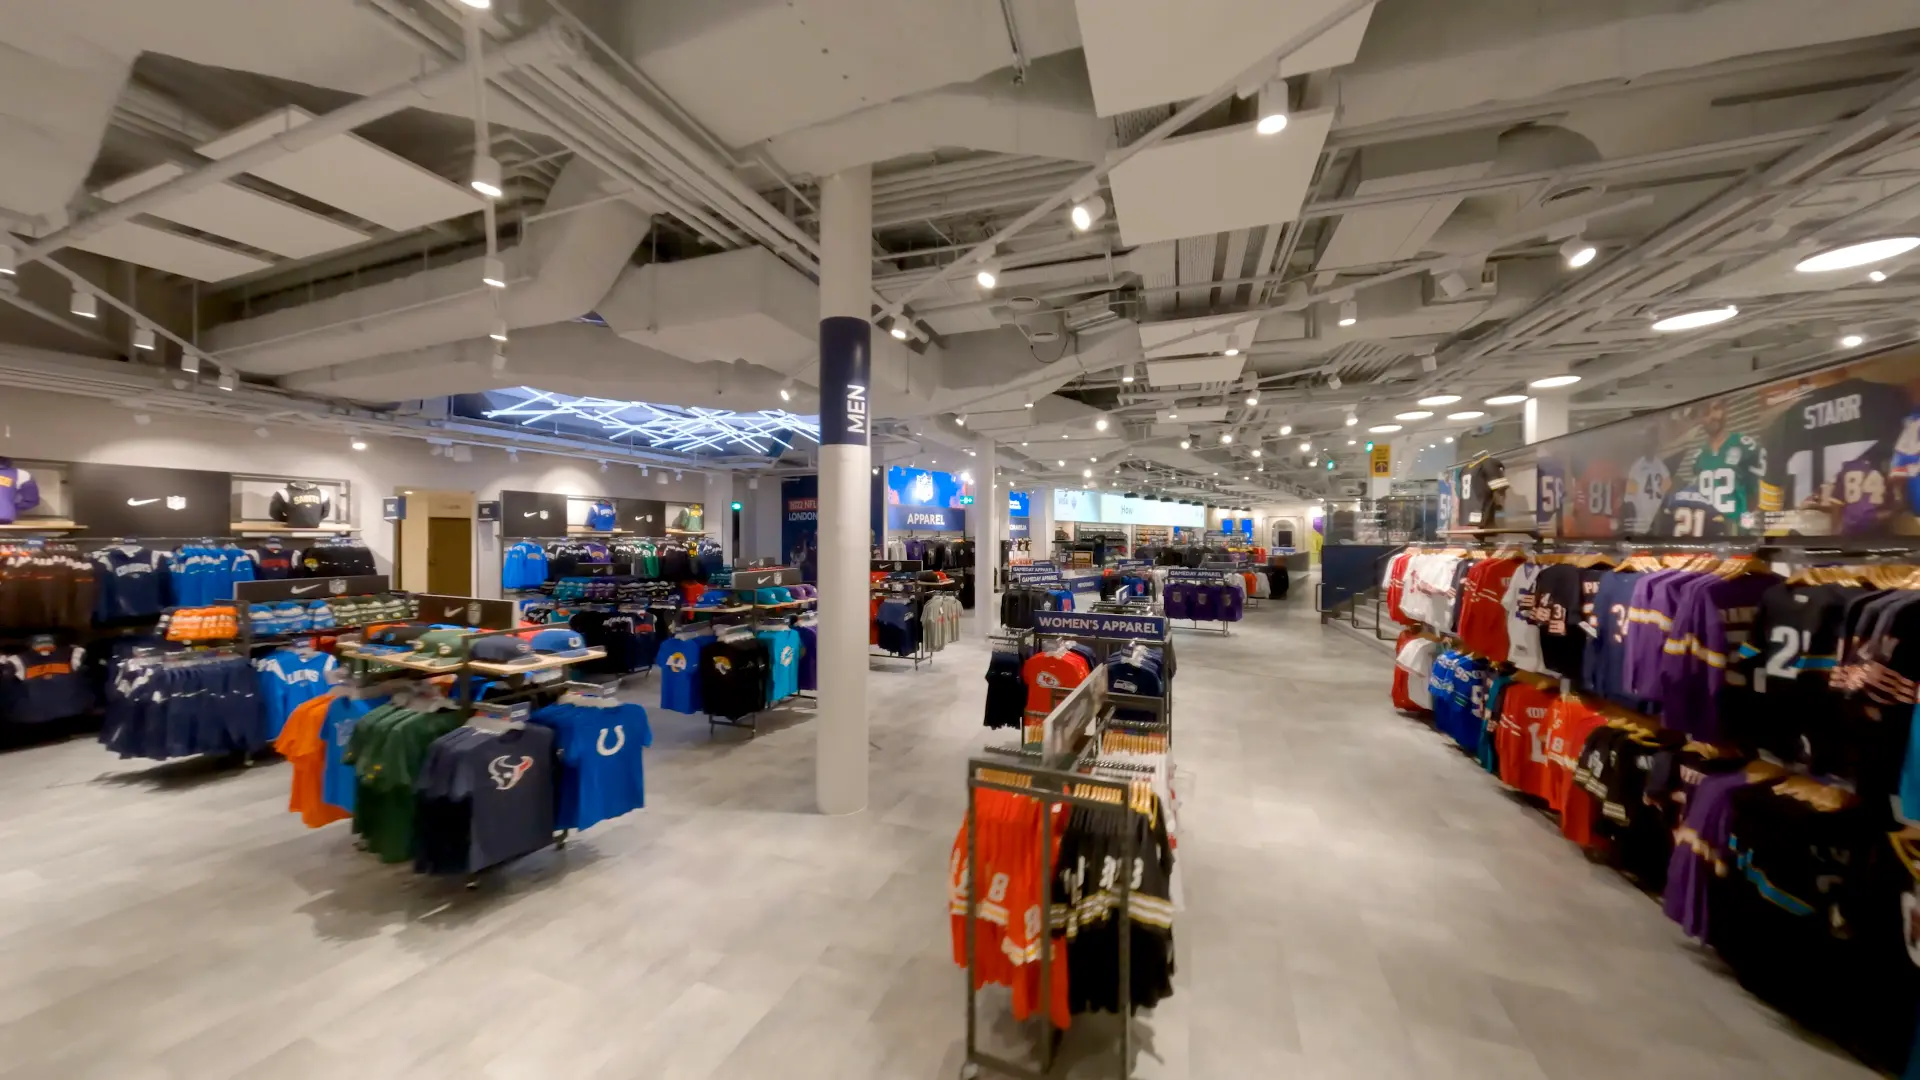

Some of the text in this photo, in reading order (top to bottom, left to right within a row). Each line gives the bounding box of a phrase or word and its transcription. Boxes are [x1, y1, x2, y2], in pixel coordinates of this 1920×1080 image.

[847, 384, 866, 433] MEN
[1803, 393, 1863, 430] STARR
[1588, 478, 1612, 516] 81
[1699, 467, 1736, 513] 92
[1843, 469, 1886, 505] 84
[907, 513, 945, 526] APPAREL
[1672, 506, 1706, 537] 21
[1022, 575, 1041, 583] GAMEDAY
[1039, 616, 1158, 634] WOMEN'S APPAREL
